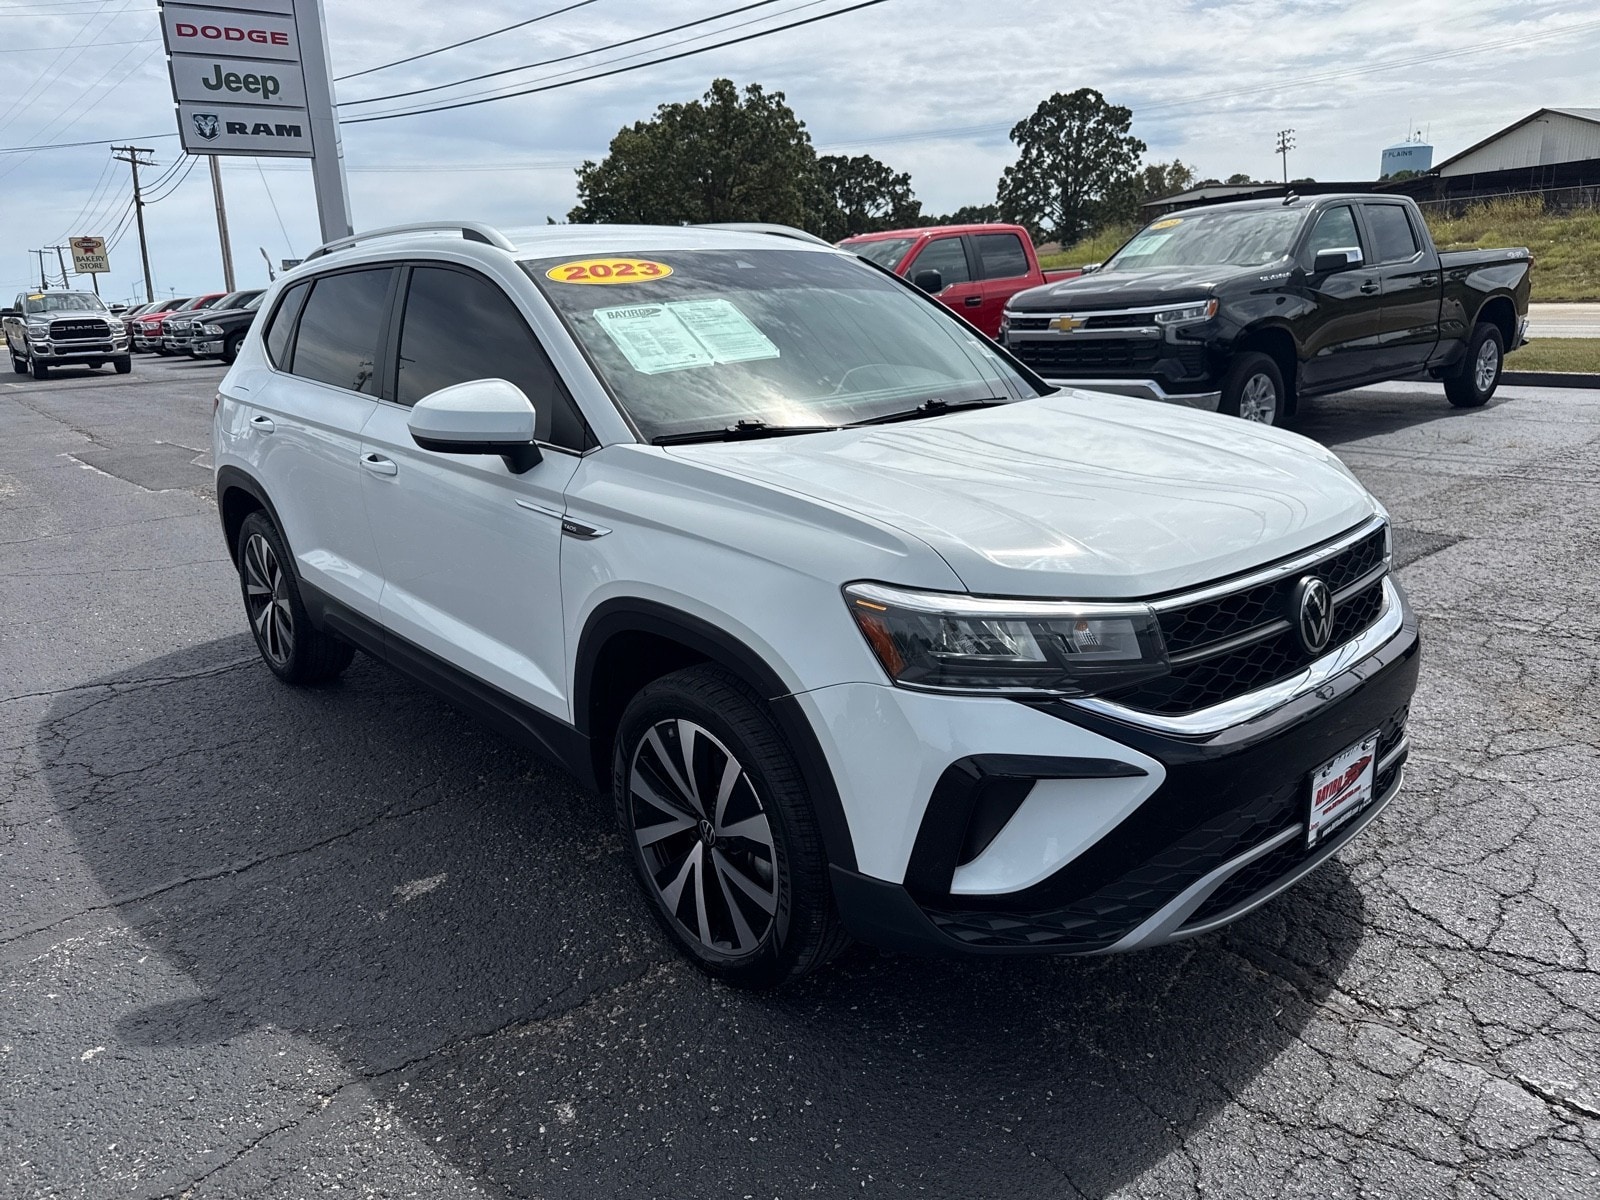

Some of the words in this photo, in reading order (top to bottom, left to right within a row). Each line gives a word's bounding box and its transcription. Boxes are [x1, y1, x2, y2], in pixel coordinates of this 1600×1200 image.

[175, 23, 289, 46] DODGE
[202, 64, 280, 100] Jeep
[225, 121, 303, 138] RAM
[1388, 150, 1413, 158] PLAINS
[563, 262, 663, 281] 2023
[606, 308, 647, 319] BAYIRD
[563, 523, 577, 532] TAOS
